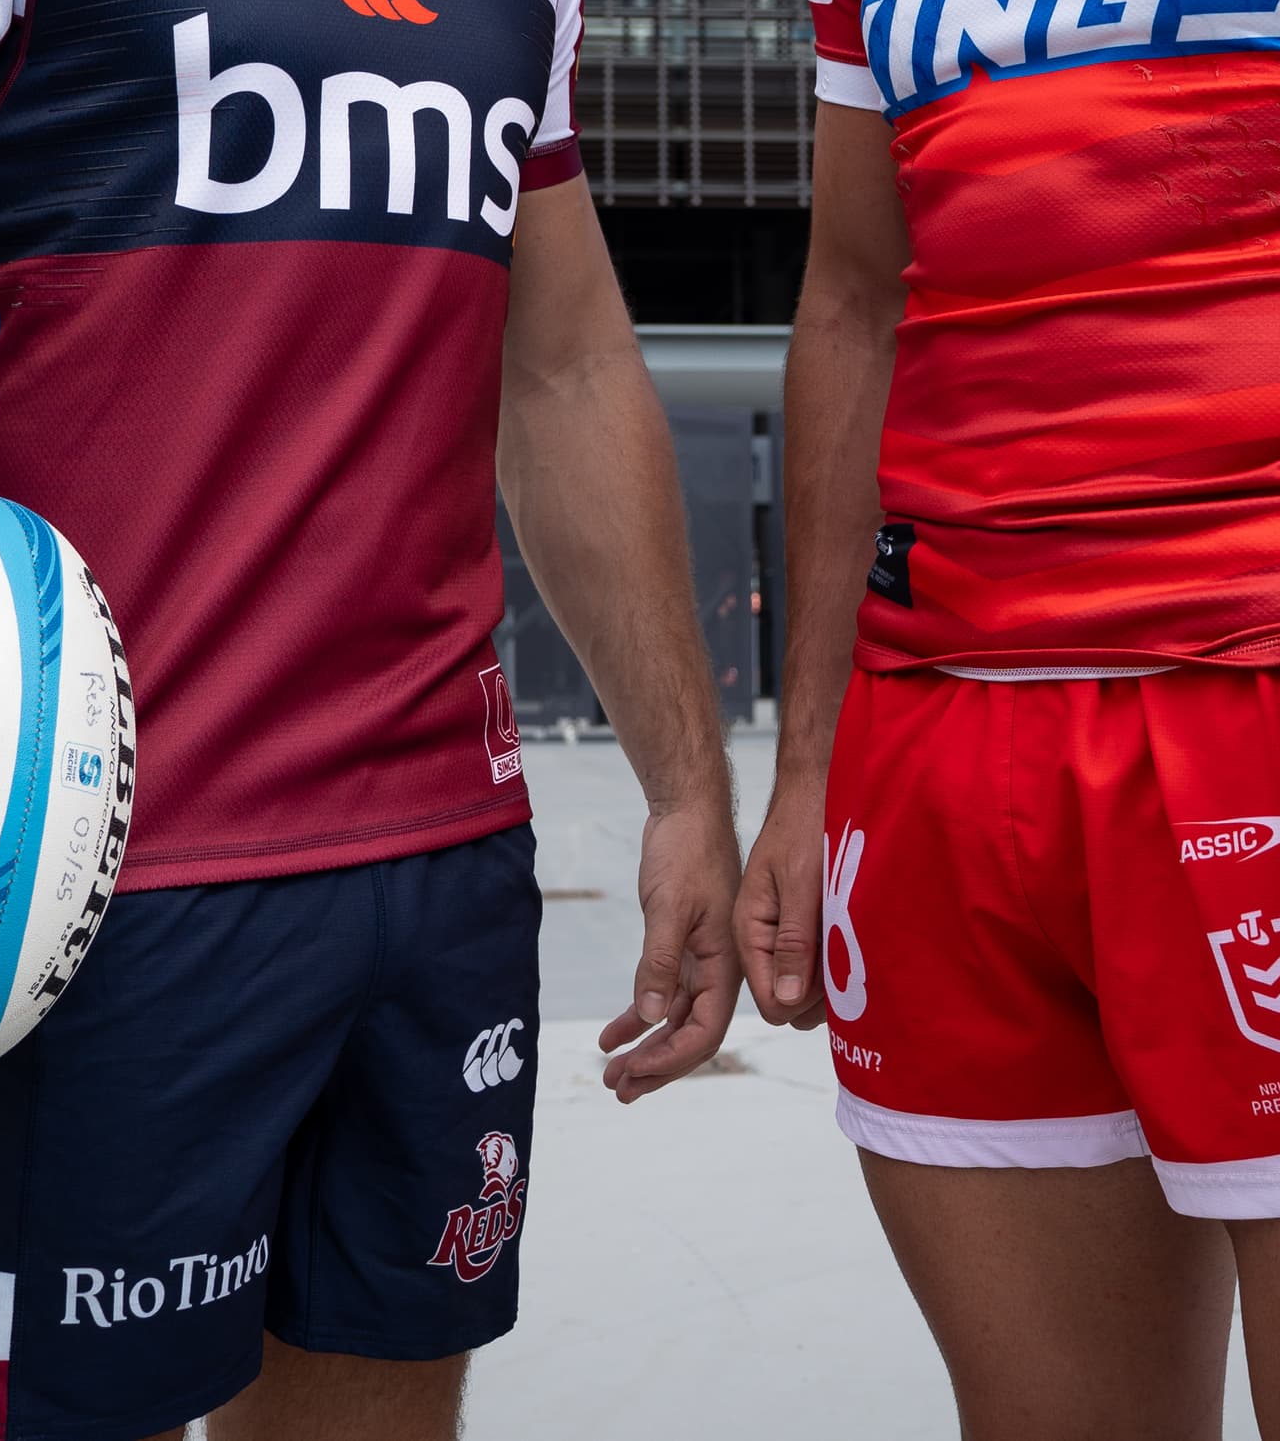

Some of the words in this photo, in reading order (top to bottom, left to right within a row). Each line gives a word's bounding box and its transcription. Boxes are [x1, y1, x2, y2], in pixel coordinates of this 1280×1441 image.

[173, 13, 537, 238] bms
[65, 747, 75, 782] PACIFIC
[496, 755, 517, 776] SINCE
[56, 816, 90, 902] 03/25
[1179, 826, 1258, 863] ASSIC
[27, 973, 45, 996] PSI
[831, 1030, 882, 1072] 2PLAY?
[426, 1178, 526, 1283] REDS
[60, 1267, 166, 1328] Rio
[170, 1234, 270, 1311] Tinto
